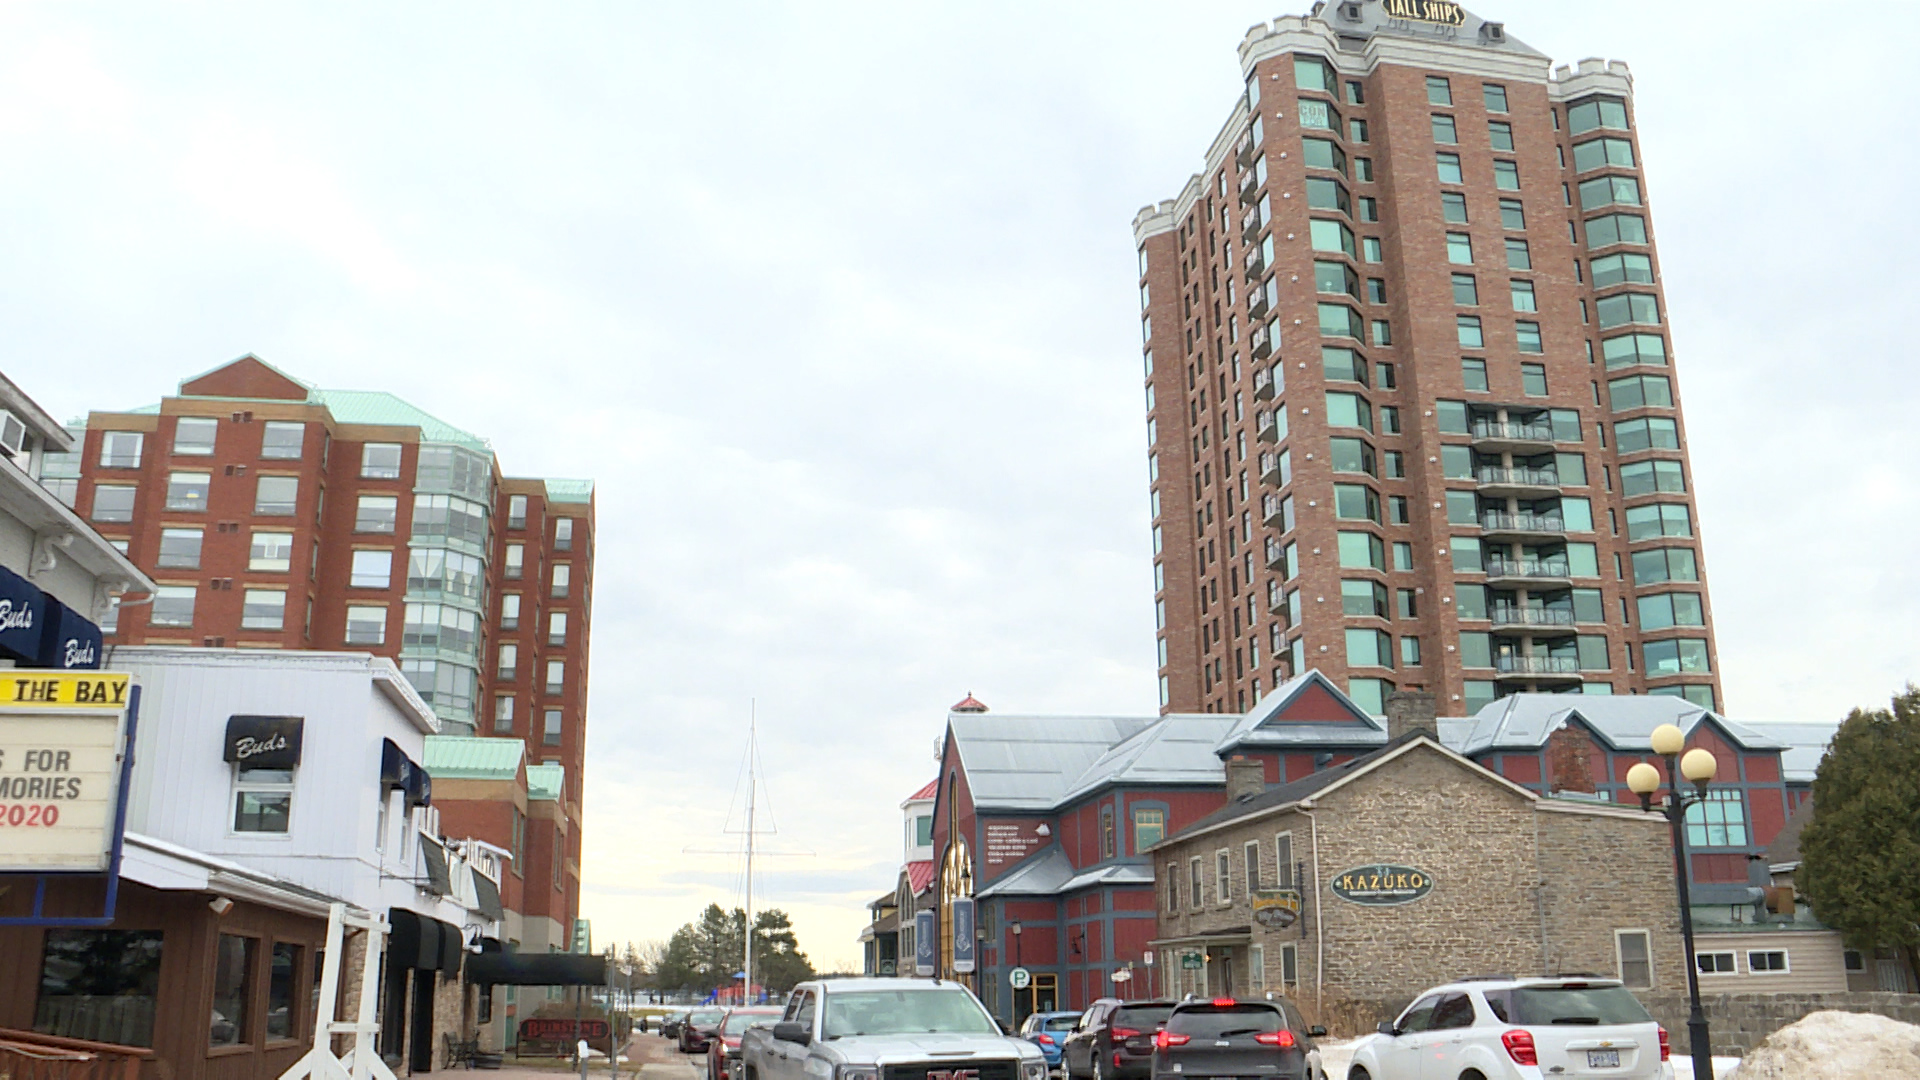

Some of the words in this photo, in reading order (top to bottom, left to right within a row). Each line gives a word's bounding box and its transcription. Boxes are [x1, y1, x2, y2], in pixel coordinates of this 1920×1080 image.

[1422, 1, 1461, 24] SHIPS
[0, 599, 33, 632] Buds
[64, 638, 95, 668] Buds
[13, 679, 59, 702] THE
[75, 680, 127, 704] BAY
[235, 732, 287, 758] Buds
[24, 749, 71, 772] FOR
[1342, 873, 1423, 890] KAZUKO
[1014, 970, 1026, 985] P
